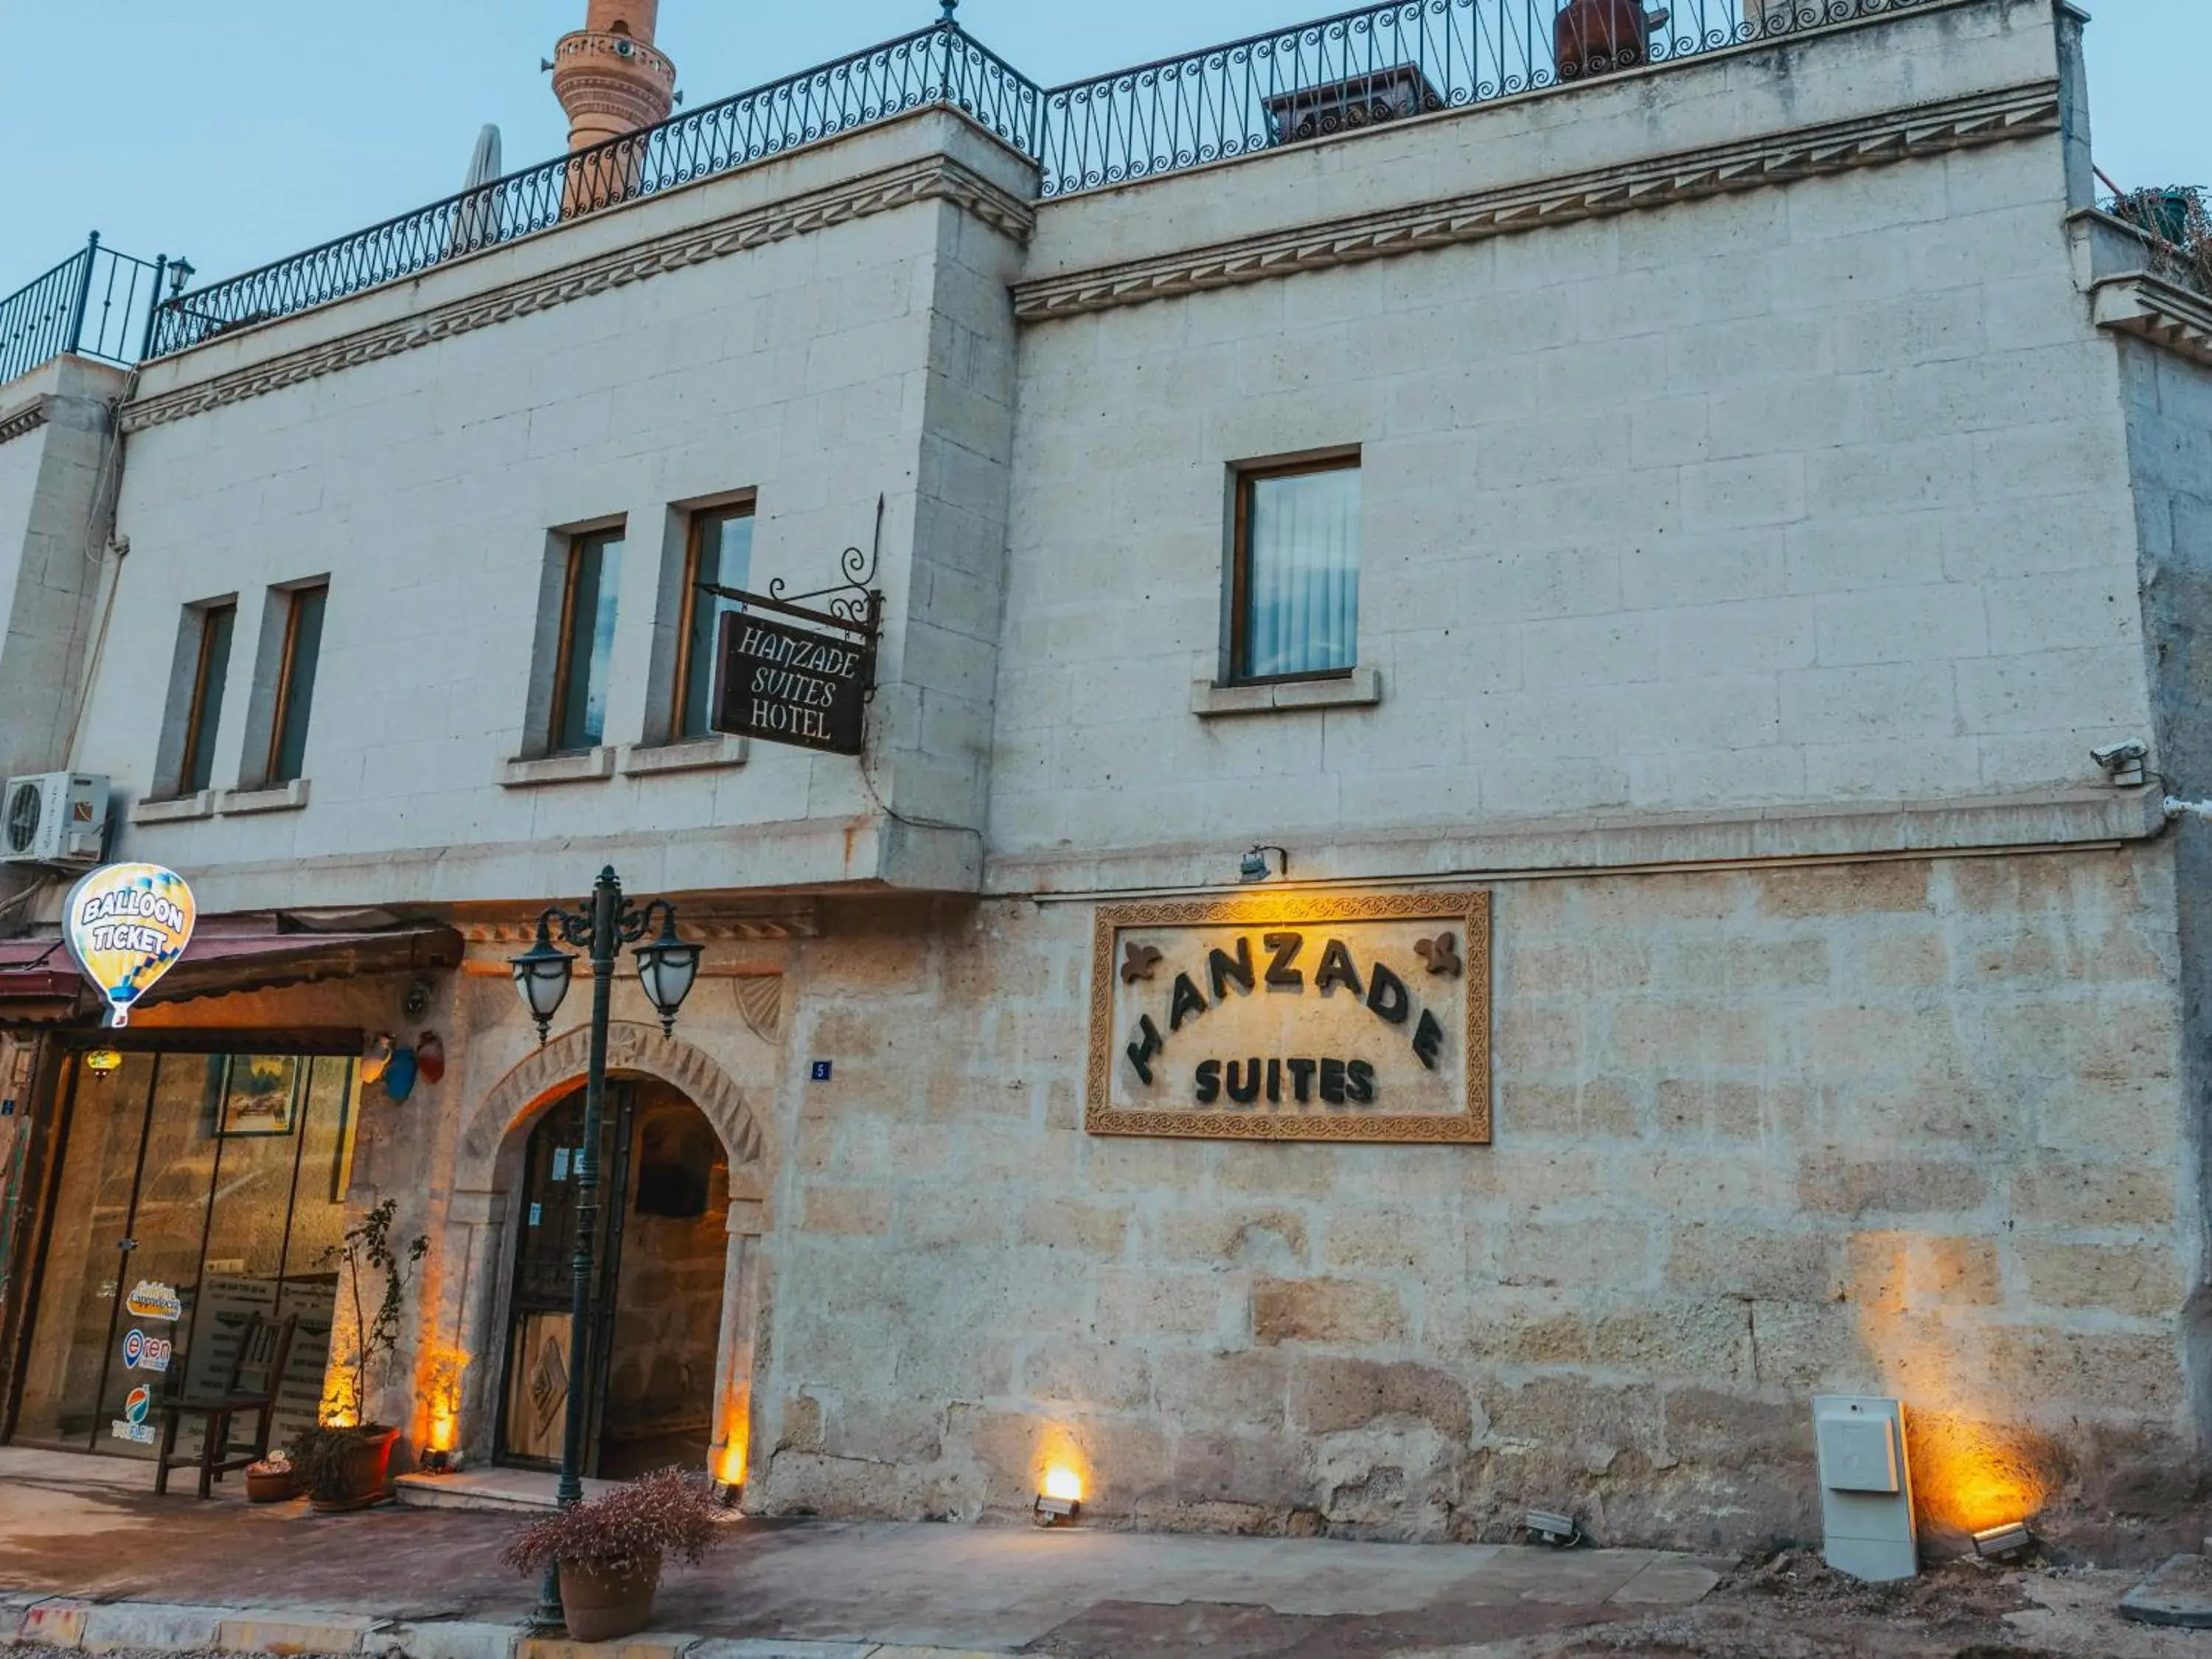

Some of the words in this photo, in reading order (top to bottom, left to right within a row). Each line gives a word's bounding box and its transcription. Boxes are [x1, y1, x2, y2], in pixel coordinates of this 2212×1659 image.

[738, 627, 859, 679] HANZADE
[751, 667, 836, 708] SUITES
[751, 698, 831, 740] HOTEL
[81, 890, 184, 933] BALLOON
[93, 923, 167, 955] TICKET
[1127, 932, 1443, 1085] HANZADE
[818, 1064, 824, 1077] 5
[1195, 1057, 1374, 1105] SUITES
[129, 1337, 170, 1359] eren
